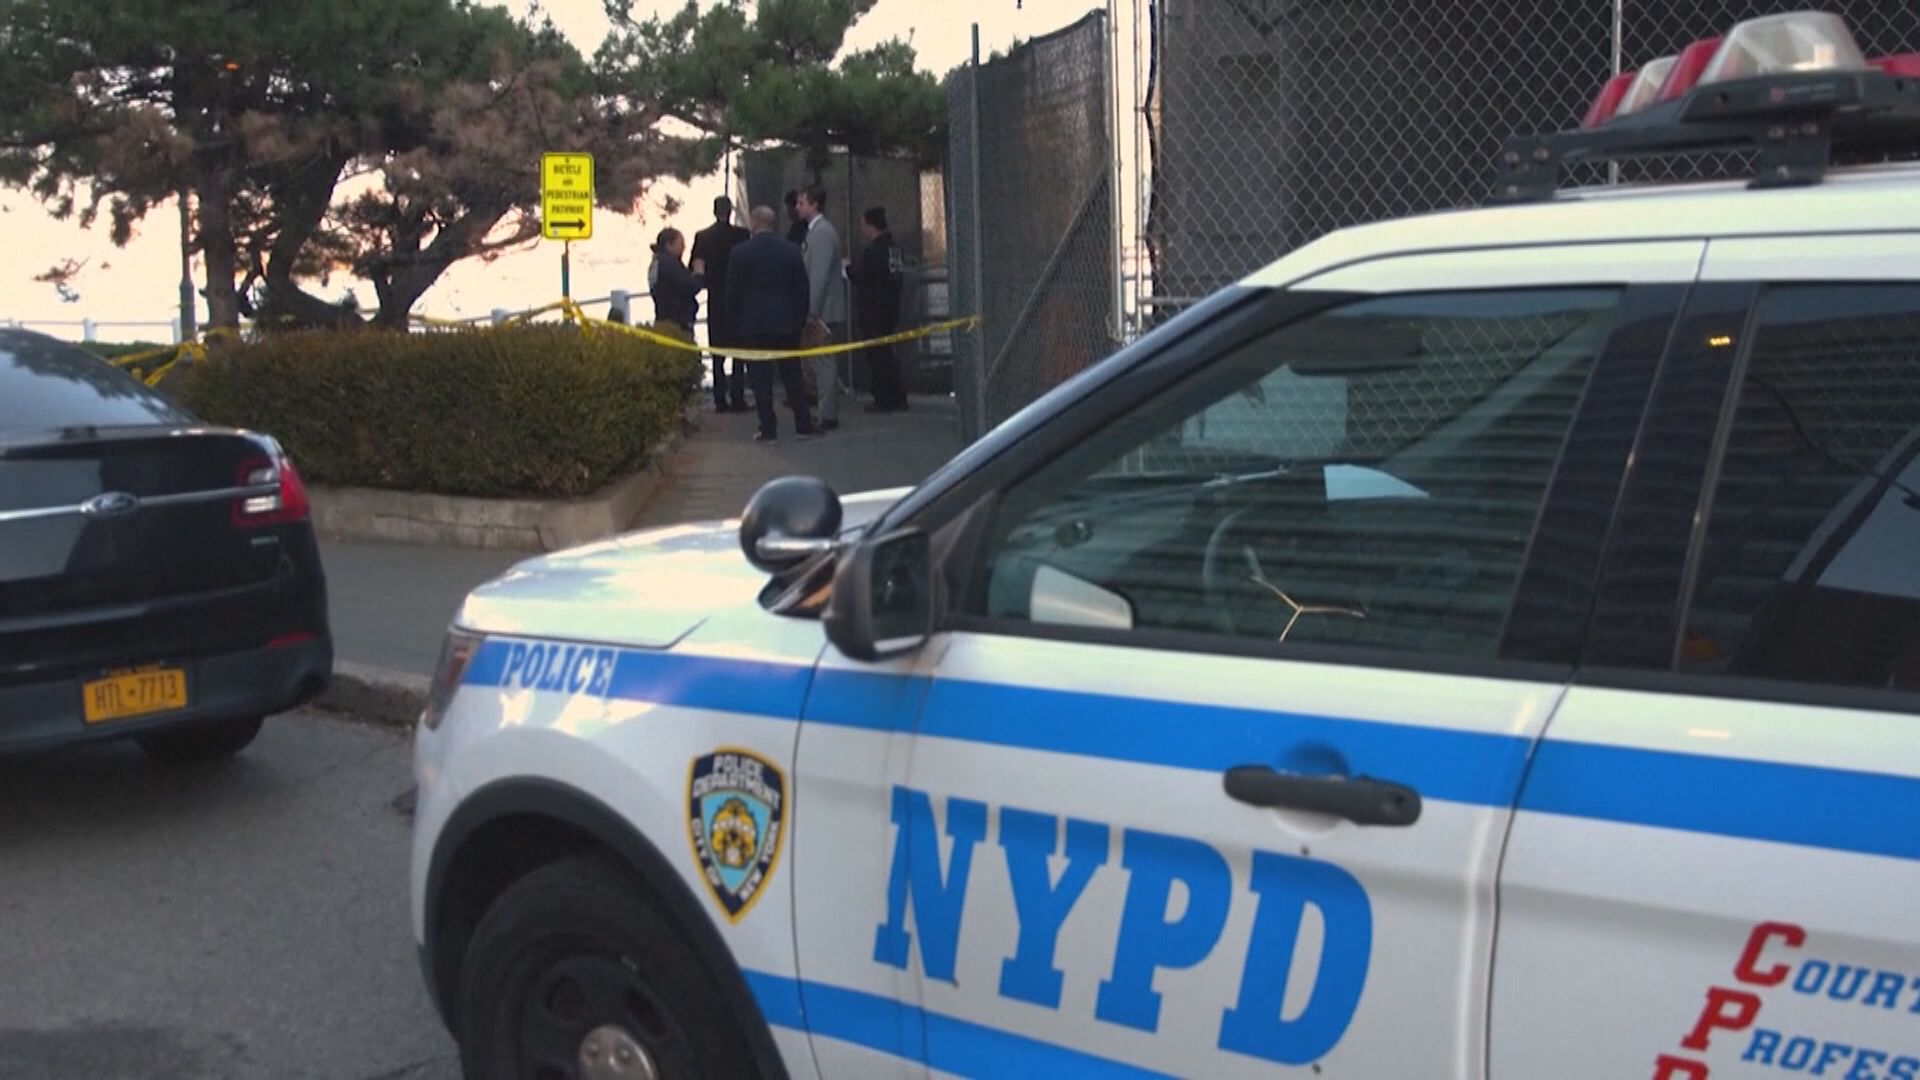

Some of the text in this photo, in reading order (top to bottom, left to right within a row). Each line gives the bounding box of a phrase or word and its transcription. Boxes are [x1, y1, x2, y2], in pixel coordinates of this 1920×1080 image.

[546, 190, 589, 199] PEDESTRIAN
[551, 205, 584, 214] PATHWAY
[501, 642, 615, 695] POLICE
[712, 754, 764, 782] POLICE
[693, 773, 780, 811] DEPARTMENT
[873, 784, 1373, 1067] NYPD
